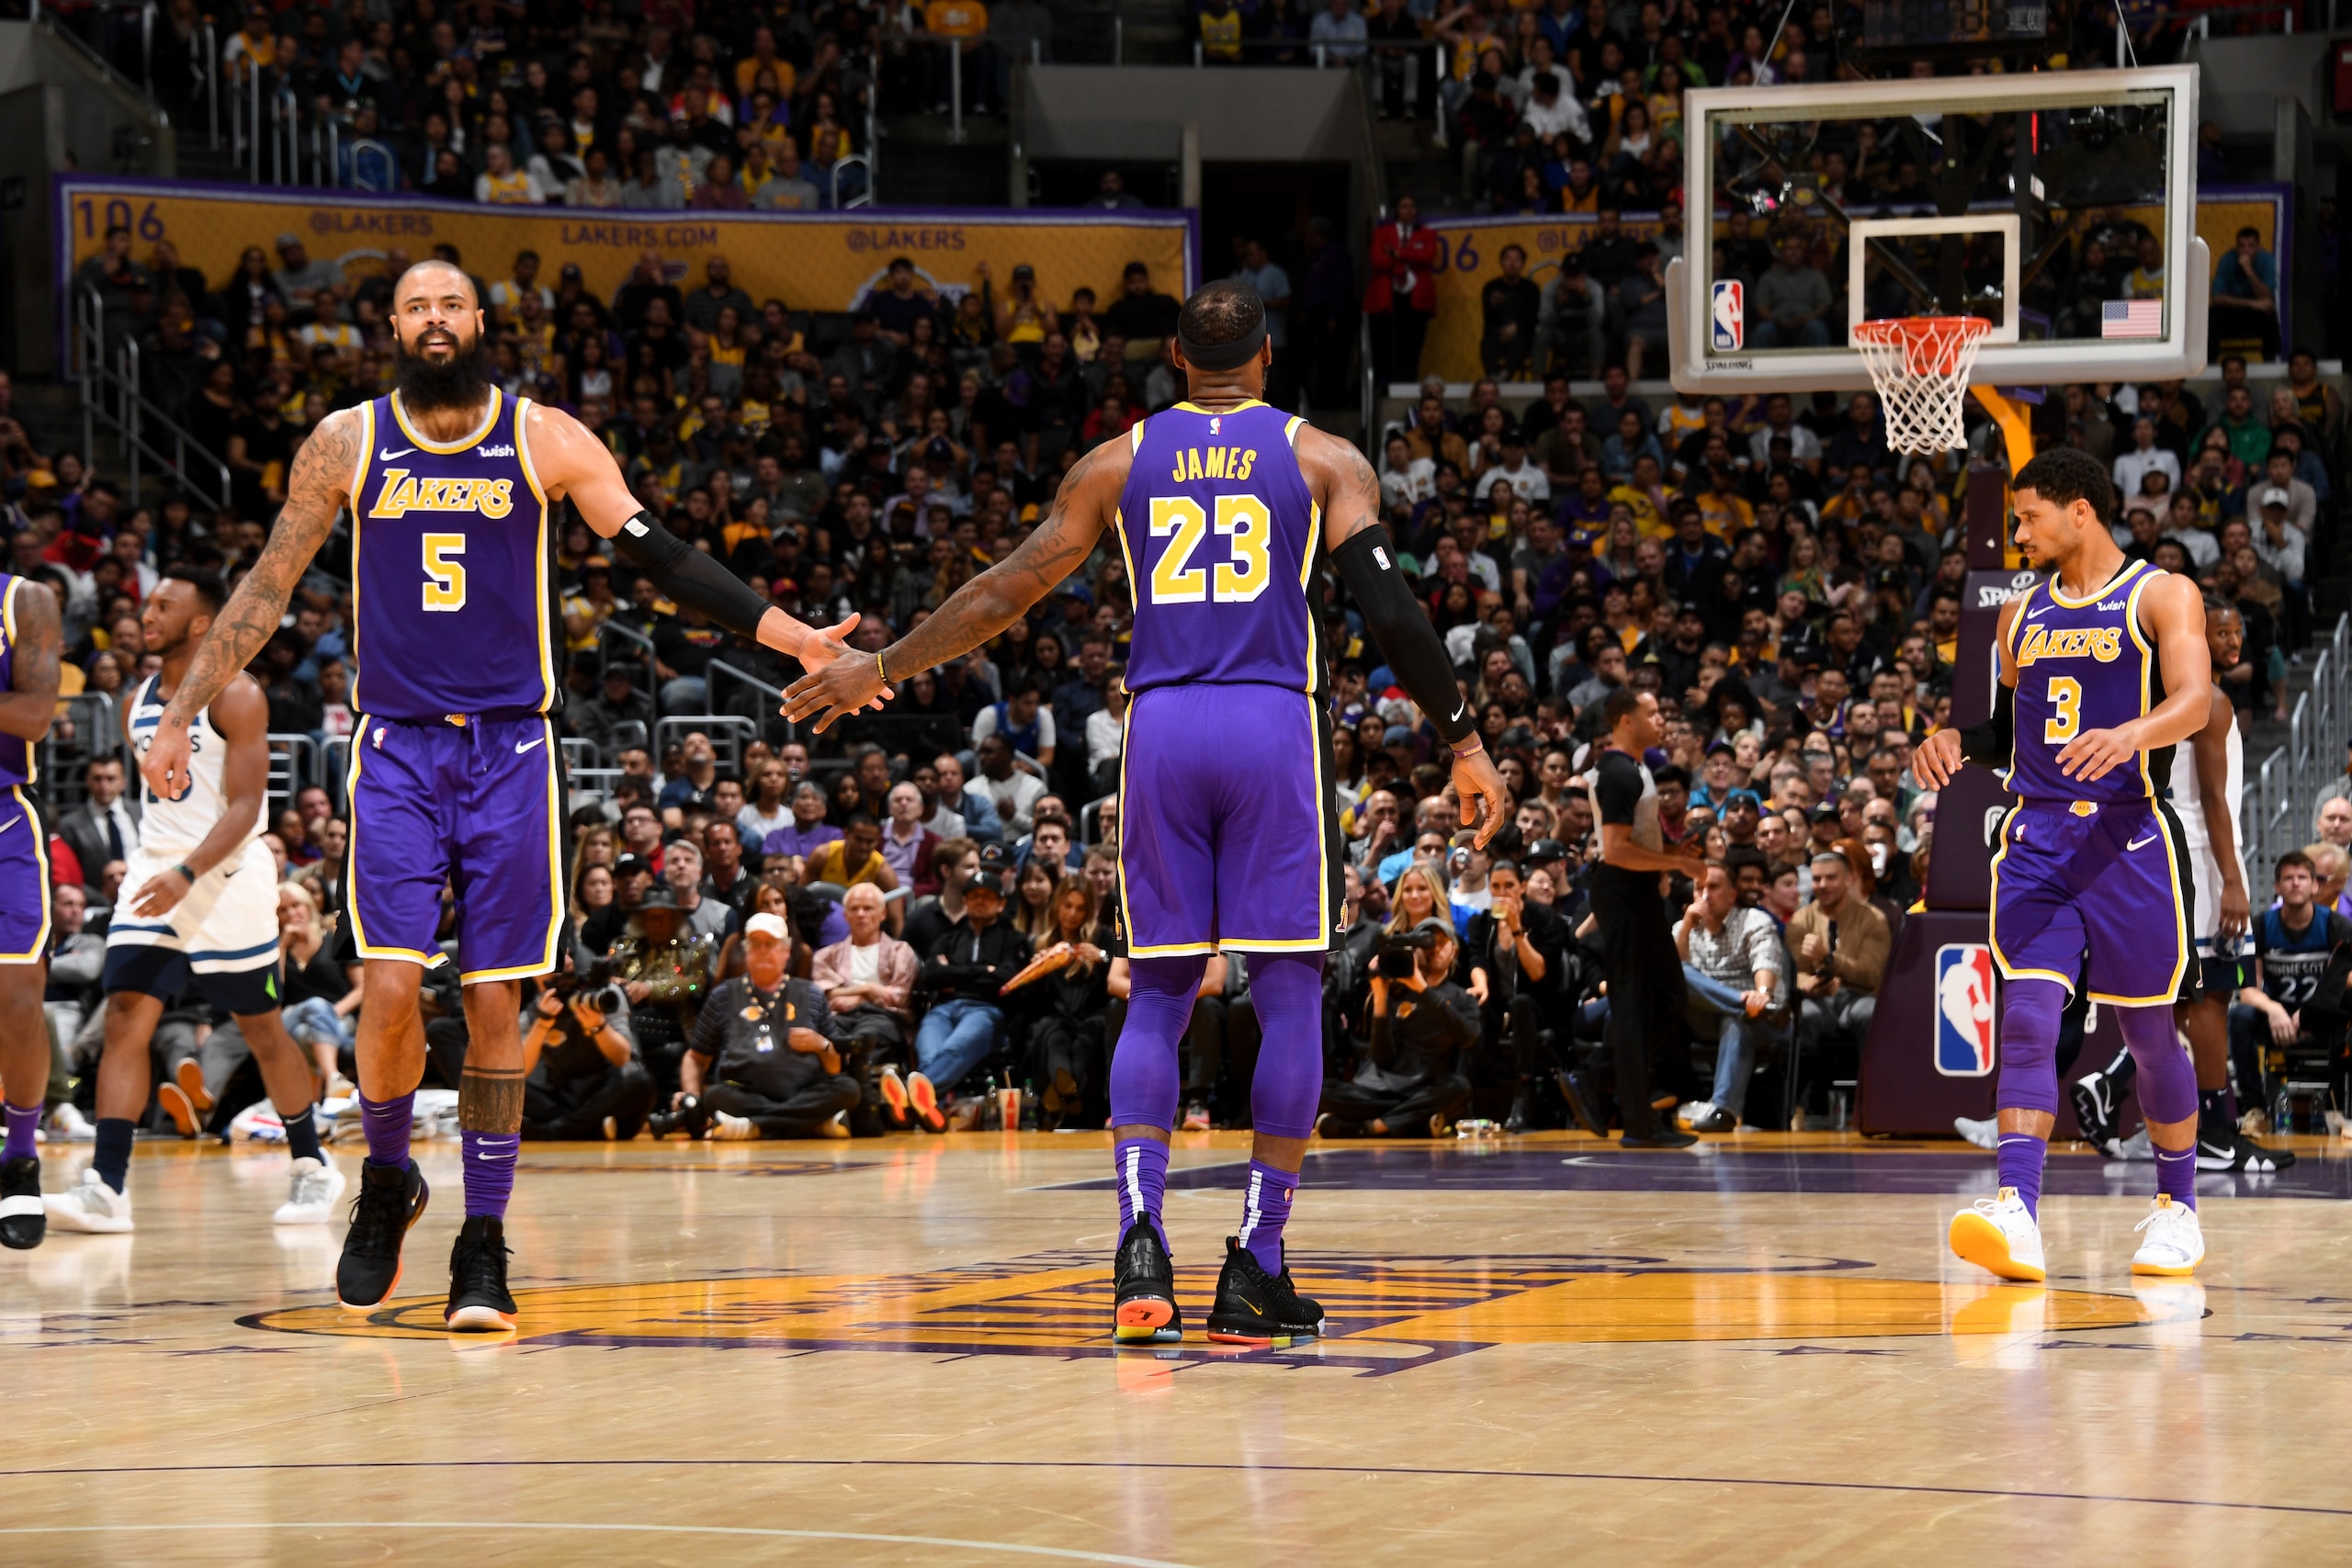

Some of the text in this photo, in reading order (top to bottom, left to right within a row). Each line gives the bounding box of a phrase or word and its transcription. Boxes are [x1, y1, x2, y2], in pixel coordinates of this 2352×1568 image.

[78, 199, 164, 241] 106
[310, 211, 435, 236] @LAKERS
[561, 224, 718, 248] LAKERS.COM
[847, 229, 966, 253] @LAKERS
[1704, 360, 1753, 372] SPALDING
[476, 445, 515, 457] wish
[1171, 446, 1257, 482] JAMES
[368, 468, 514, 520] LAKERS
[1148, 494, 1271, 605] 23
[422, 533, 466, 612] 5
[2096, 600, 2126, 612] wish
[2016, 624, 2122, 669] LAKERS
[2044, 676, 2082, 745] 3
[2265, 961, 2324, 976] MINNESOT
